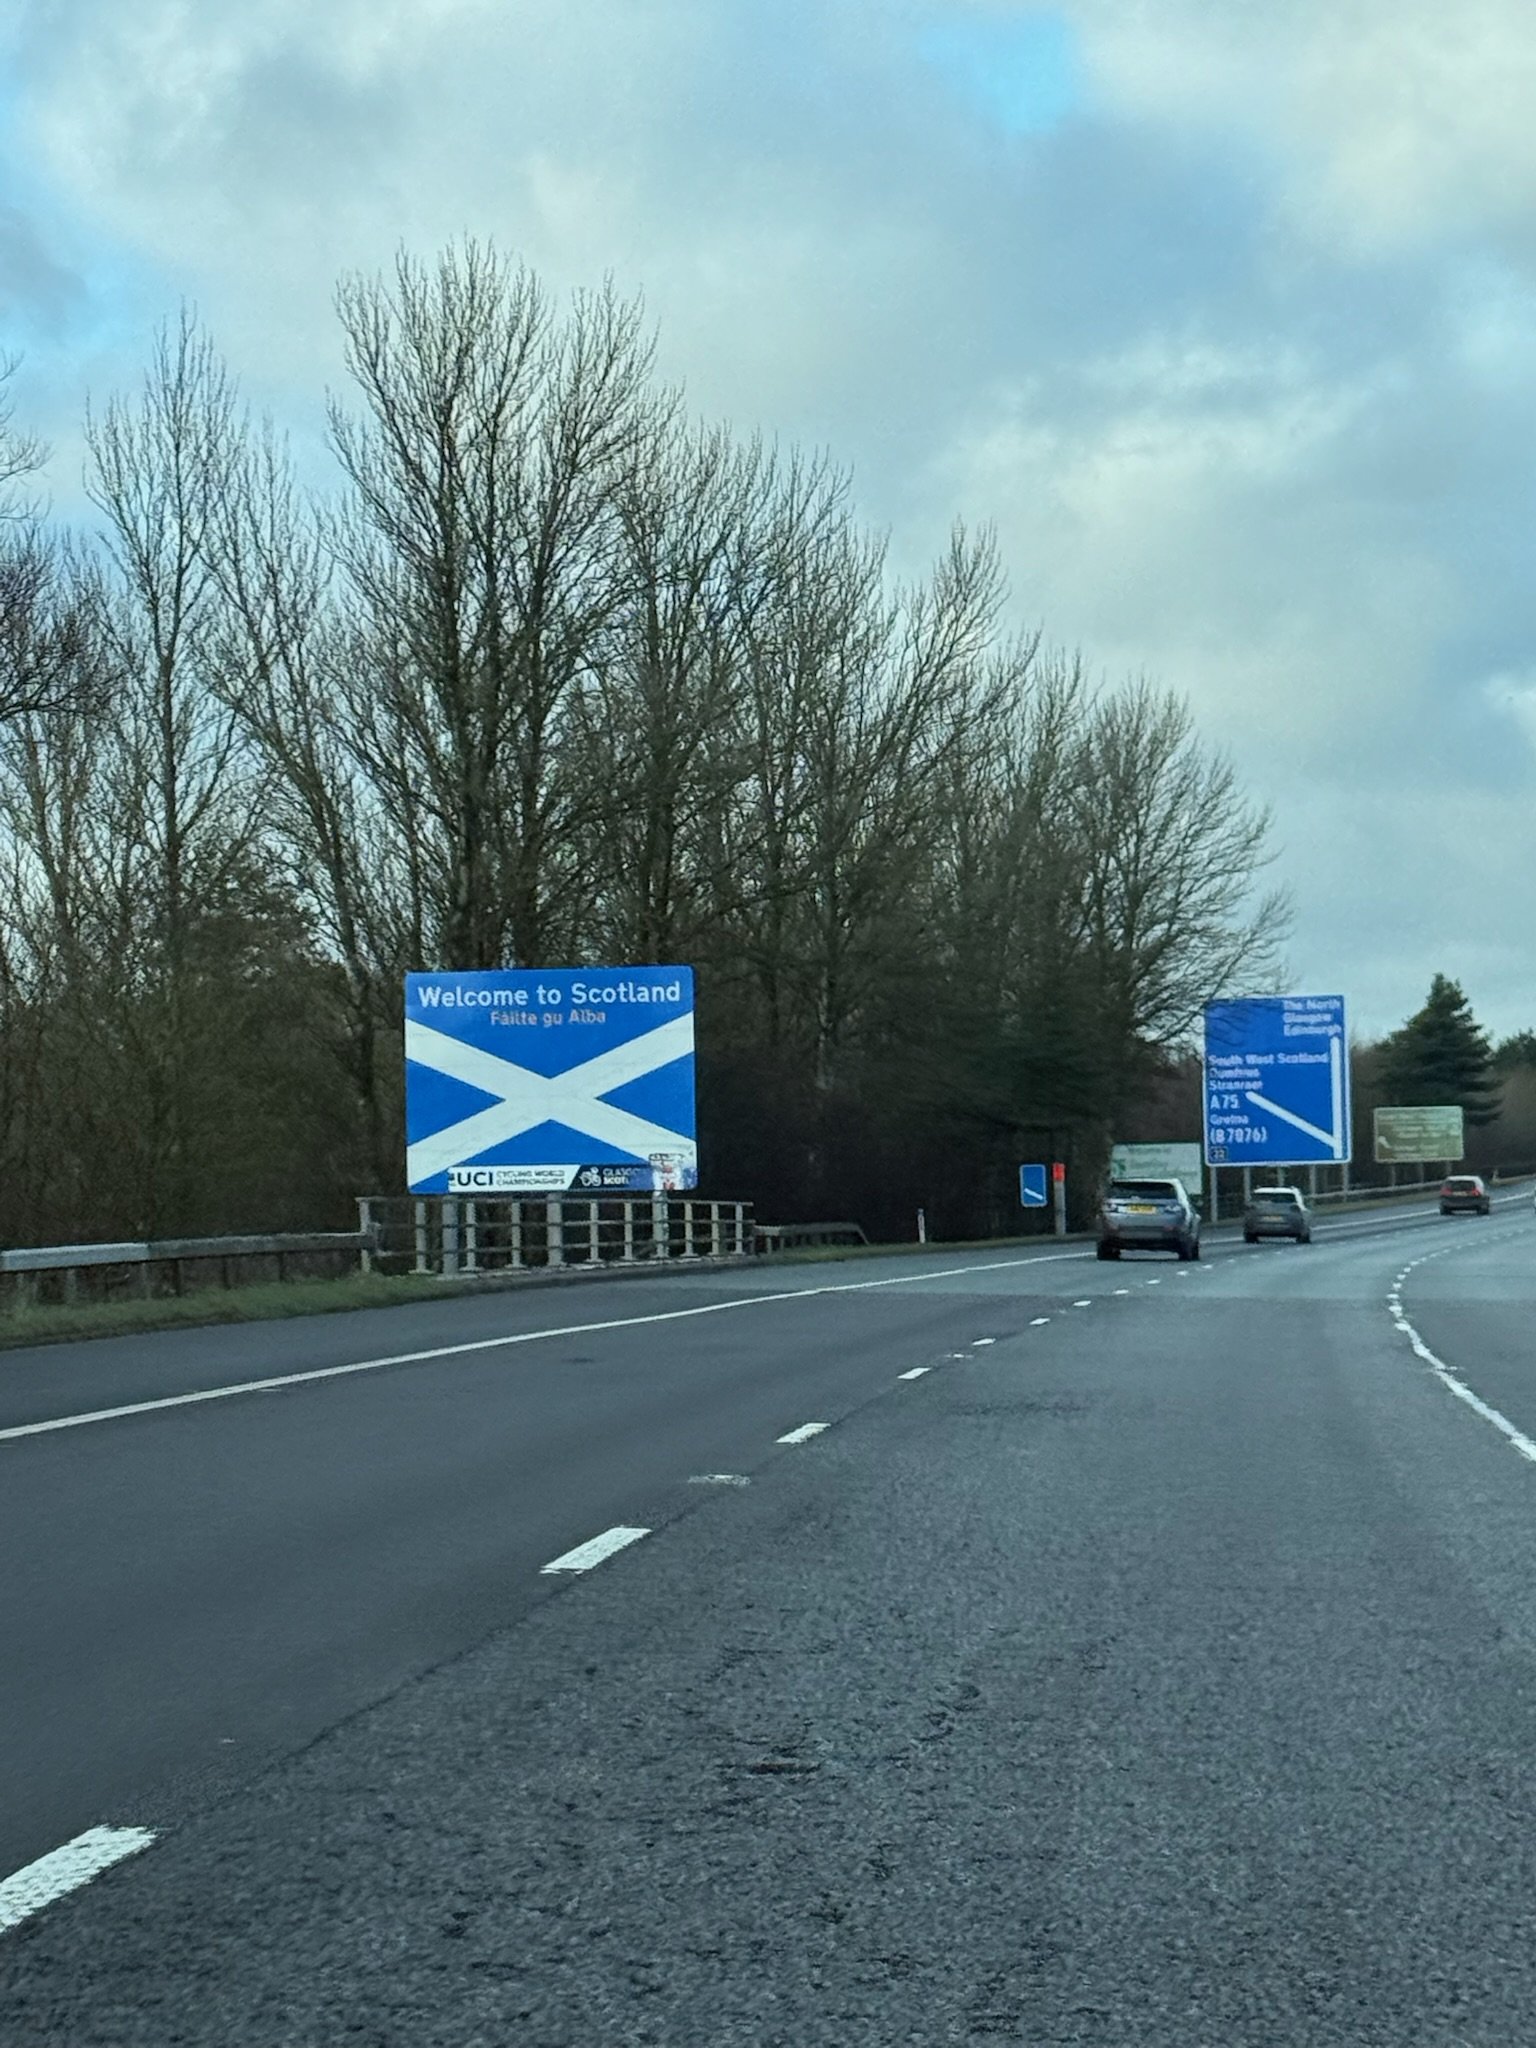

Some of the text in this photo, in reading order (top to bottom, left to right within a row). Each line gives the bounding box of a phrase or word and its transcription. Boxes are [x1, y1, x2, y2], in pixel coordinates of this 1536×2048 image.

[418, 981, 680, 1008] Welcome to Scotland
[1282, 999, 1341, 1011] The North
[543, 1012, 563, 1028] gu
[569, 1009, 606, 1024] Alba
[1282, 1012, 1333, 1025] Glasgow
[1283, 1023, 1342, 1037] Edinburgh
[1208, 1052, 1329, 1067] South West Scotland
[457, 1171, 493, 1186] UCI
